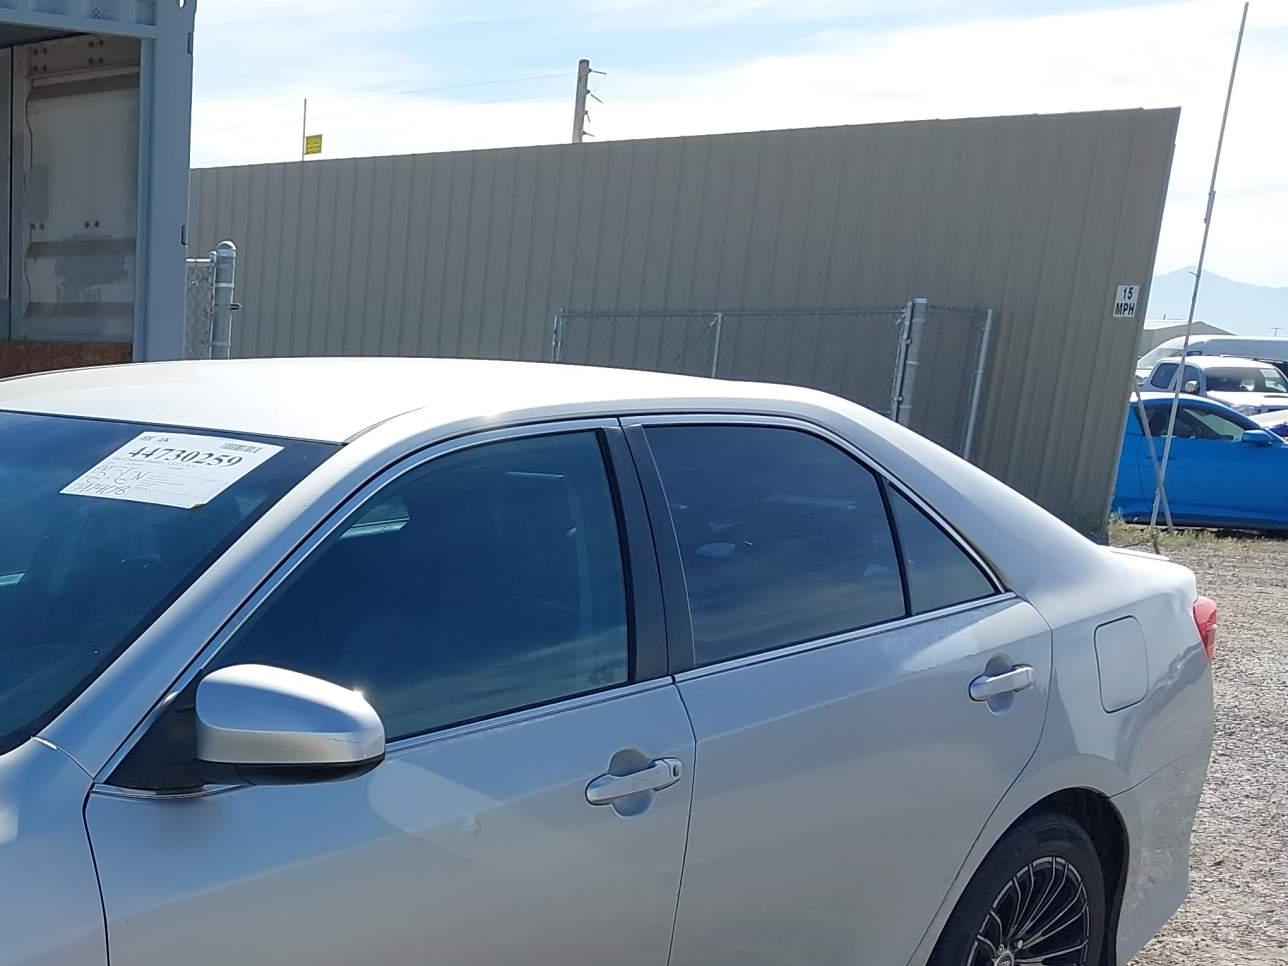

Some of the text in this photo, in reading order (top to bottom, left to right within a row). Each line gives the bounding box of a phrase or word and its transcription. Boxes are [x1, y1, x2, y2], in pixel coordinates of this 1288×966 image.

[1122, 287, 1134, 300] 15
[1114, 302, 1136, 315] MPH
[127, 446, 244, 468] 44730259
